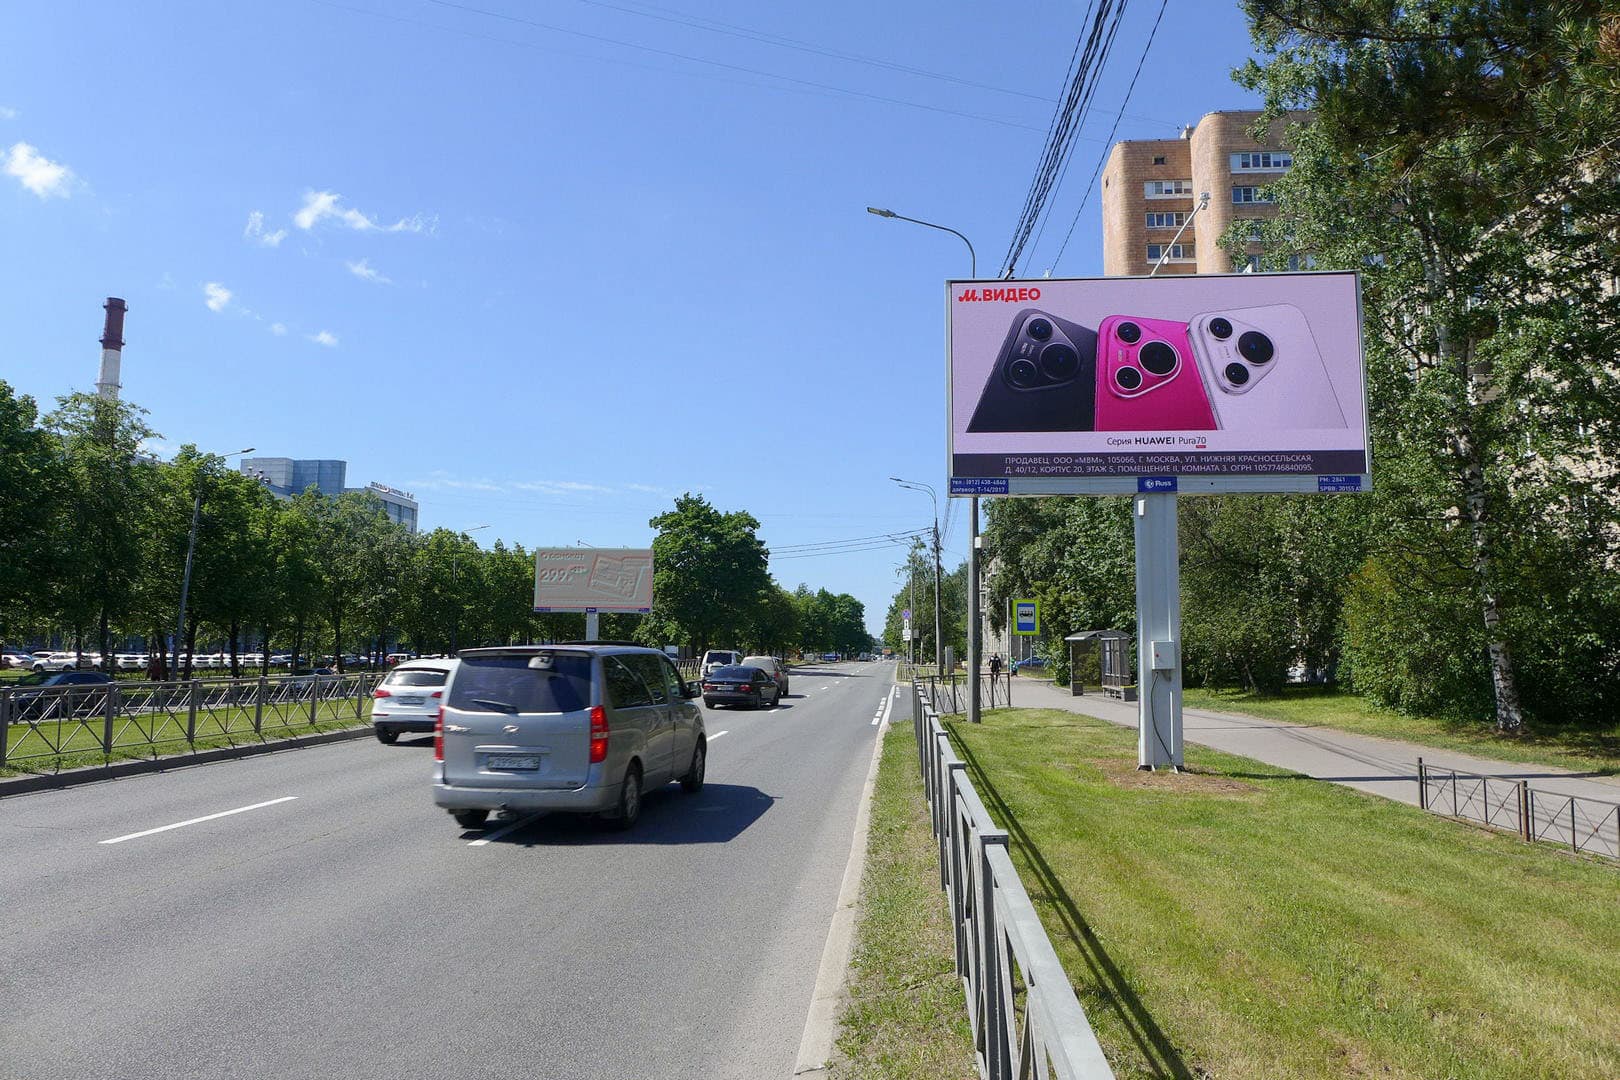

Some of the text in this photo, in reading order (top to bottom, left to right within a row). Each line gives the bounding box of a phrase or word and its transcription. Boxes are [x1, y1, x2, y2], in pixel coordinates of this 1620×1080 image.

[1106, 436, 1207, 448] Серия HUAWEI Pura70
[1053, 456, 1073, 465] ООО
[1107, 456, 1137, 464] 105066,
[1146, 455, 1183, 464] МОСКВА,
[1200, 455, 1236, 463] НИЖНЯЯ
[1238, 454, 1314, 463] КРАСНОСЕЛЬСКАЯ,
[1015, 466, 1038, 474] 40/12,
[1086, 465, 1107, 473] ЭТАЖ
[1117, 465, 1171, 473] ПОМЕЩЕНИЕ
[1181, 464, 1220, 472] КОМНАТА
[1230, 464, 1252, 472] ОГРН
